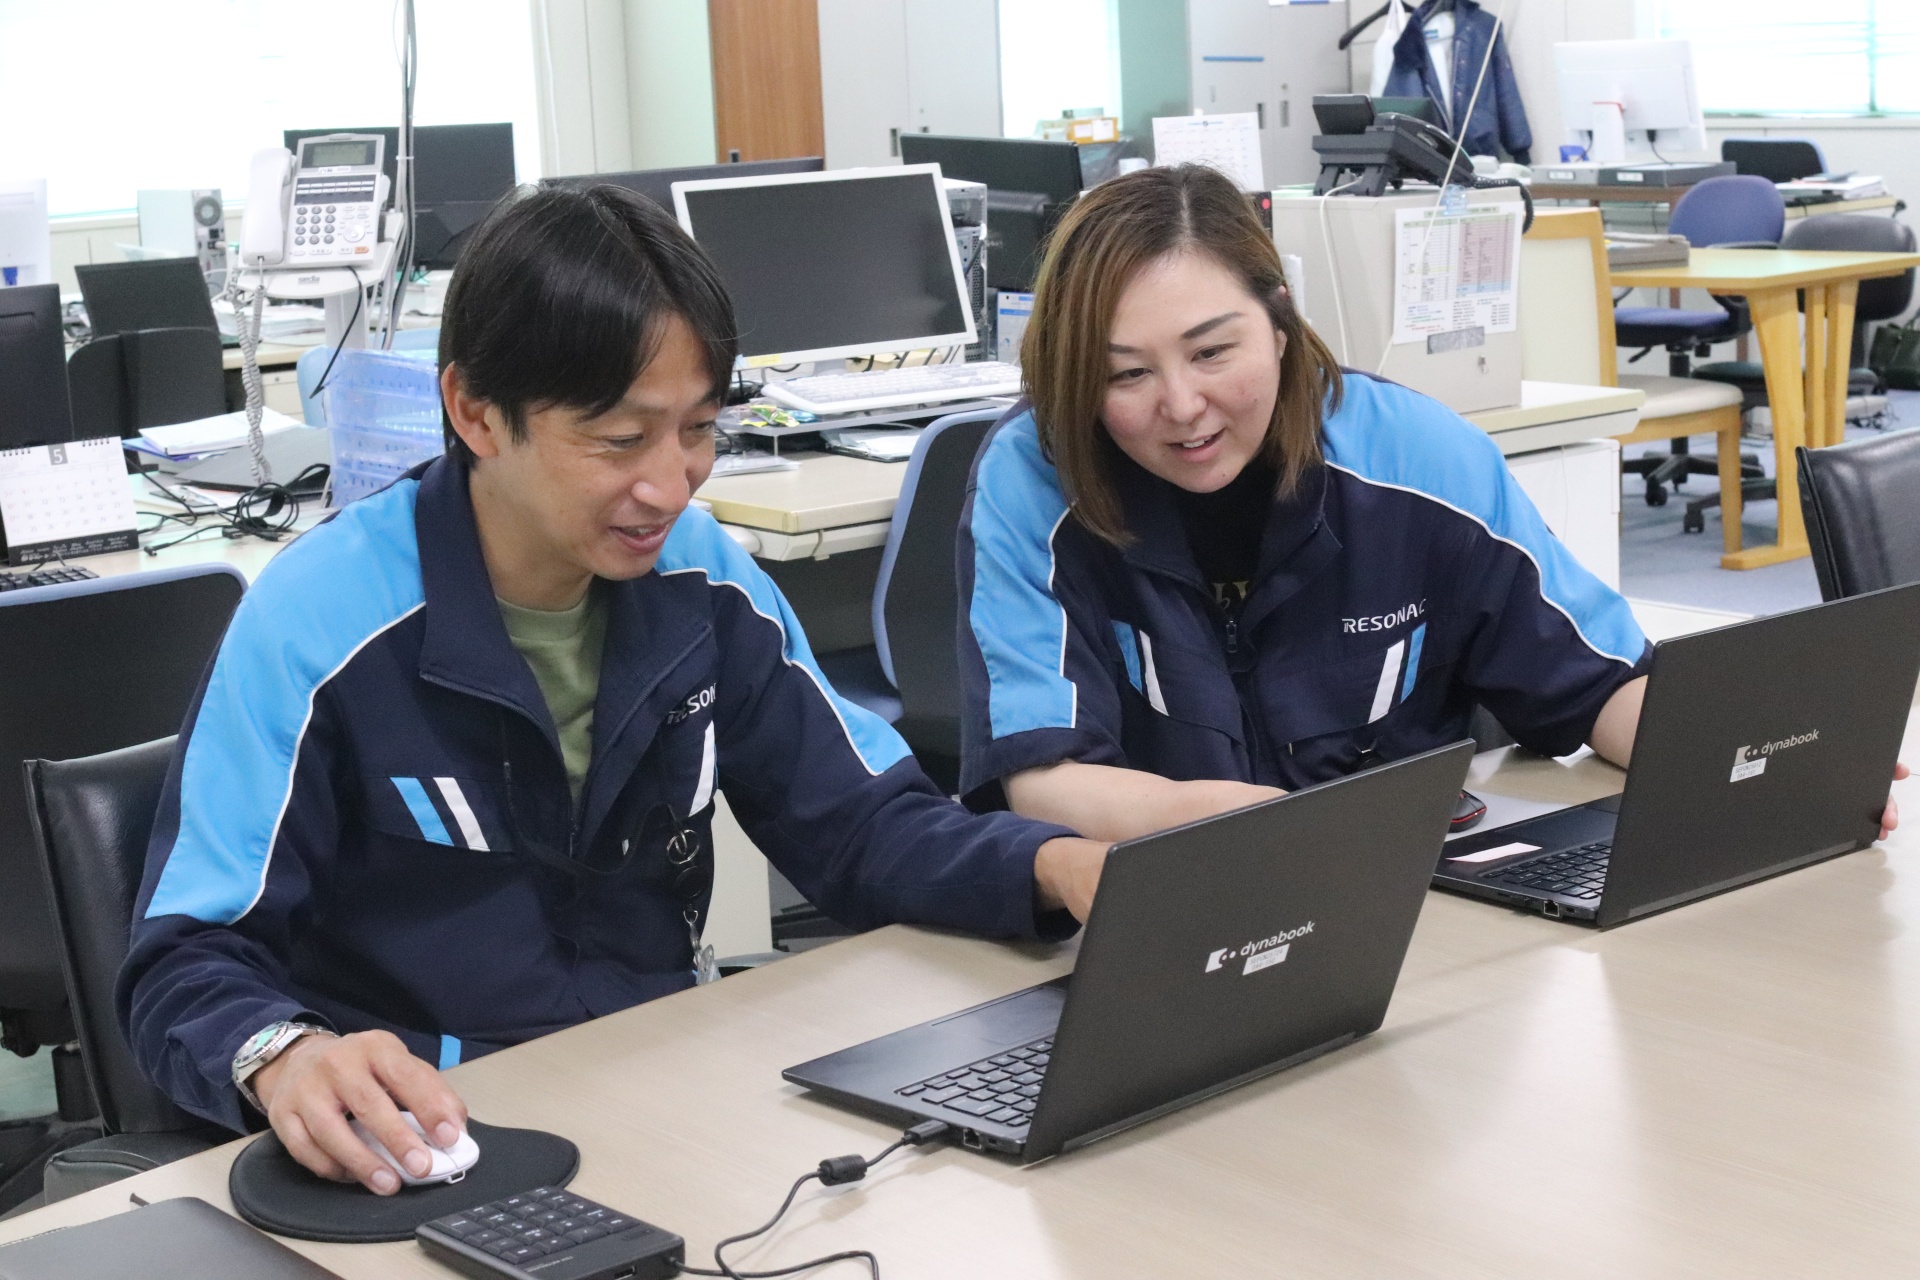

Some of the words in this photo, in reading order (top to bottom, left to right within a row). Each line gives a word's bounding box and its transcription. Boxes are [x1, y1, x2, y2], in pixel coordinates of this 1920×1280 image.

[53, 448, 63, 464] 5
[1341, 598, 1427, 634] RESONAC
[1760, 728, 1820, 755] dynabook
[1240, 920, 1316, 956] dynabook
